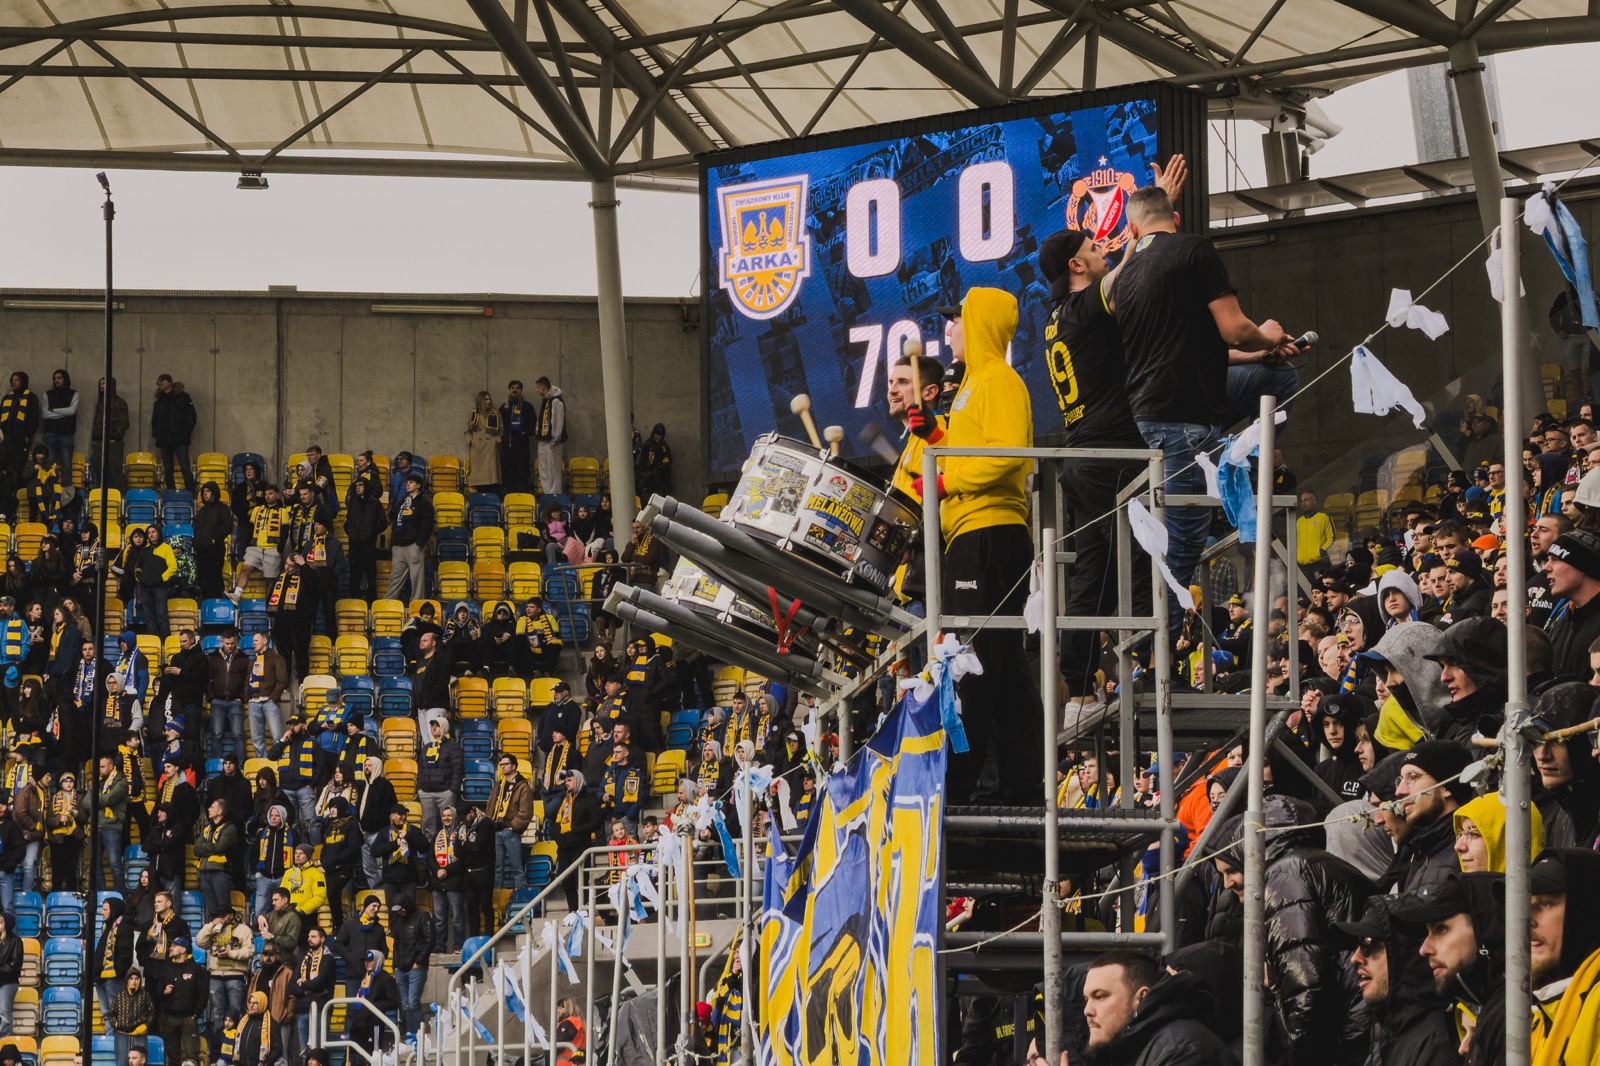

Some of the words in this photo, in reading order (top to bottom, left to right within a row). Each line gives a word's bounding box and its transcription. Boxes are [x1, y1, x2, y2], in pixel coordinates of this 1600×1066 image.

[1091, 167, 1115, 187] 1910
[773, 192, 790, 202] KLUB
[959, 161, 1014, 262] 0
[1102, 200, 1120, 231] WIDZEW
[847, 178, 900, 278] 0
[736, 252, 793, 273] ARKA
